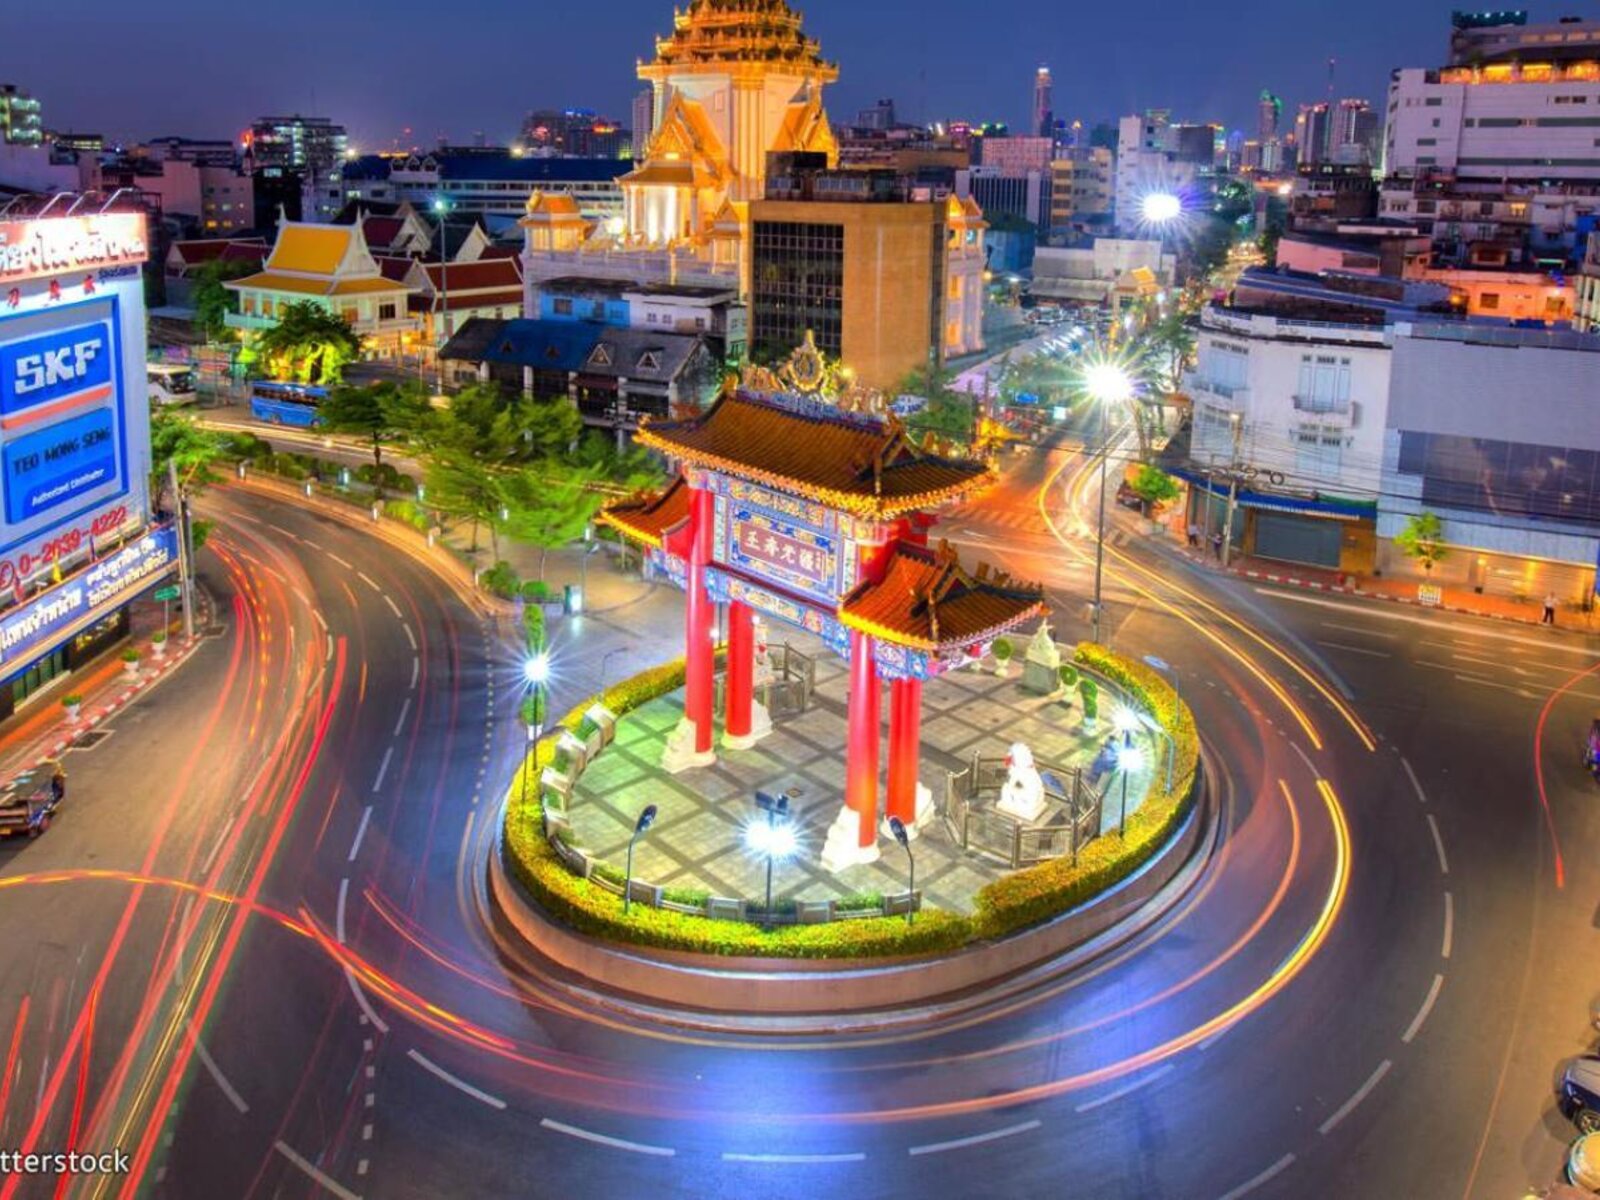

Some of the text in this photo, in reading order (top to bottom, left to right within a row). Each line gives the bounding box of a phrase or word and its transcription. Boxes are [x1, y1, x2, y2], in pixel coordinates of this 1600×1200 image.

[14, 339, 101, 394] SKF
[14, 427, 111, 475] TEO HONG SENG
